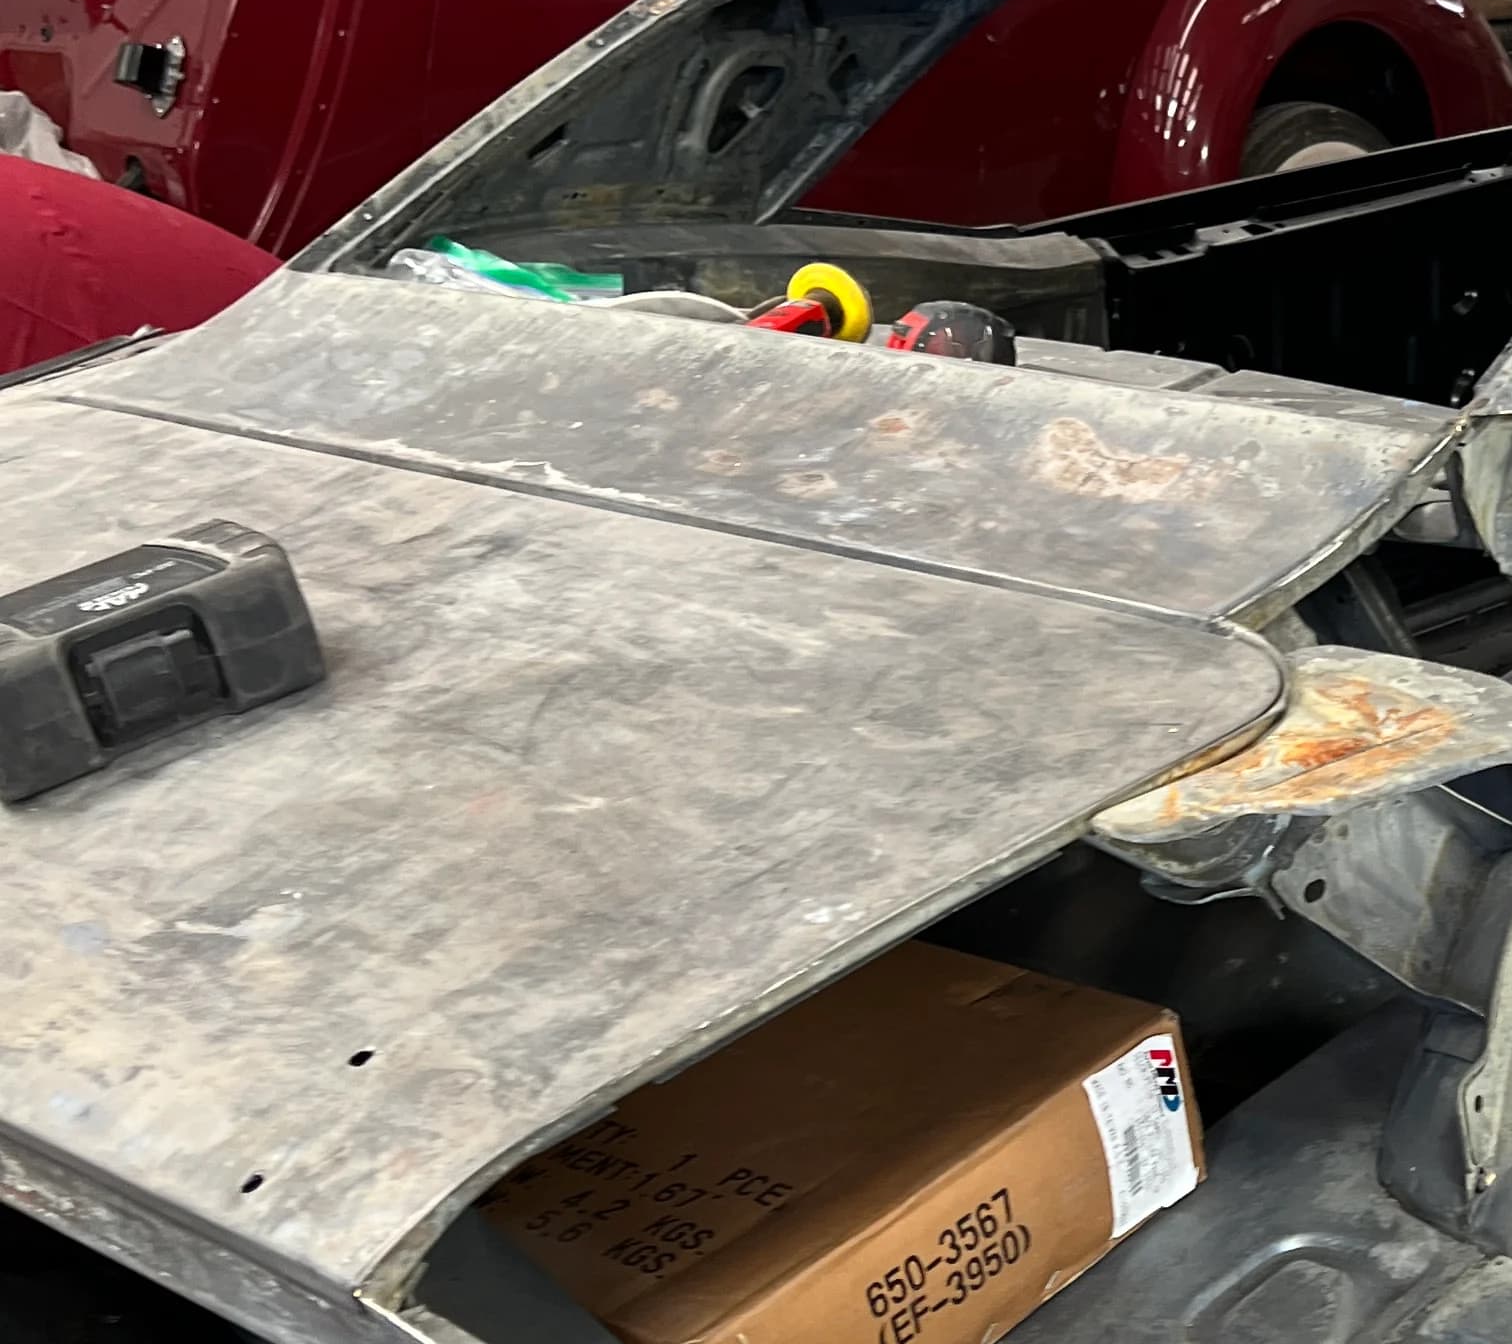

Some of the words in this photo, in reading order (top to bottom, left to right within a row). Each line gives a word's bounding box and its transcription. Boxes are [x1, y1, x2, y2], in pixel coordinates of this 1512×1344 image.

[585, 1120, 638, 1145] TY:
[667, 1153, 698, 1173] 1
[525, 1209, 593, 1243] 5.6
[600, 1237, 676, 1280] KGS.
[559, 1189, 631, 1221] 4.2
[642, 1214, 715, 1256] KGS.
[865, 1187, 1013, 1318] 650-3567
